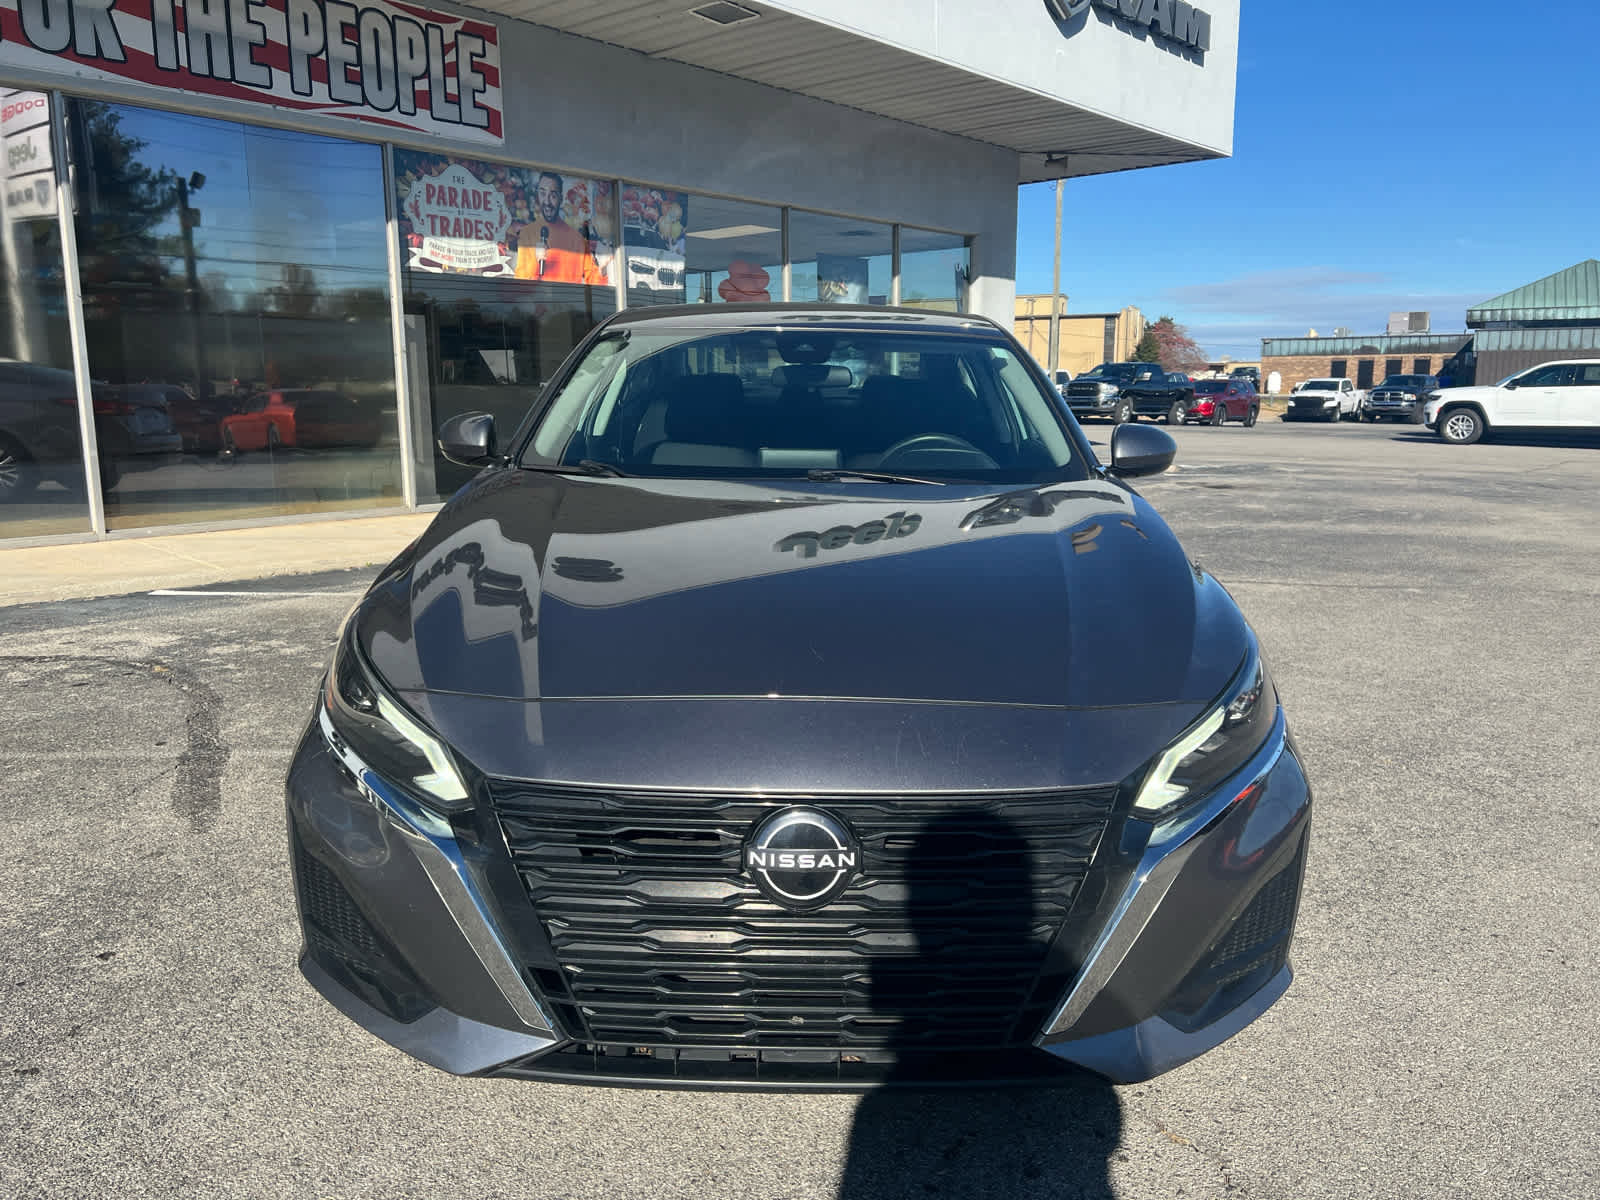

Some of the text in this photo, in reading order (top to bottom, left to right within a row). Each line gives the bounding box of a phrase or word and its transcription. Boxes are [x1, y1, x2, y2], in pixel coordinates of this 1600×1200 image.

[150, 0, 273, 89] THE
[286, 0, 490, 129] PEOPLE
[452, 175, 465, 185] THE
[425, 183, 493, 211] PARADE
[749, 851, 855, 869] NISSAN
